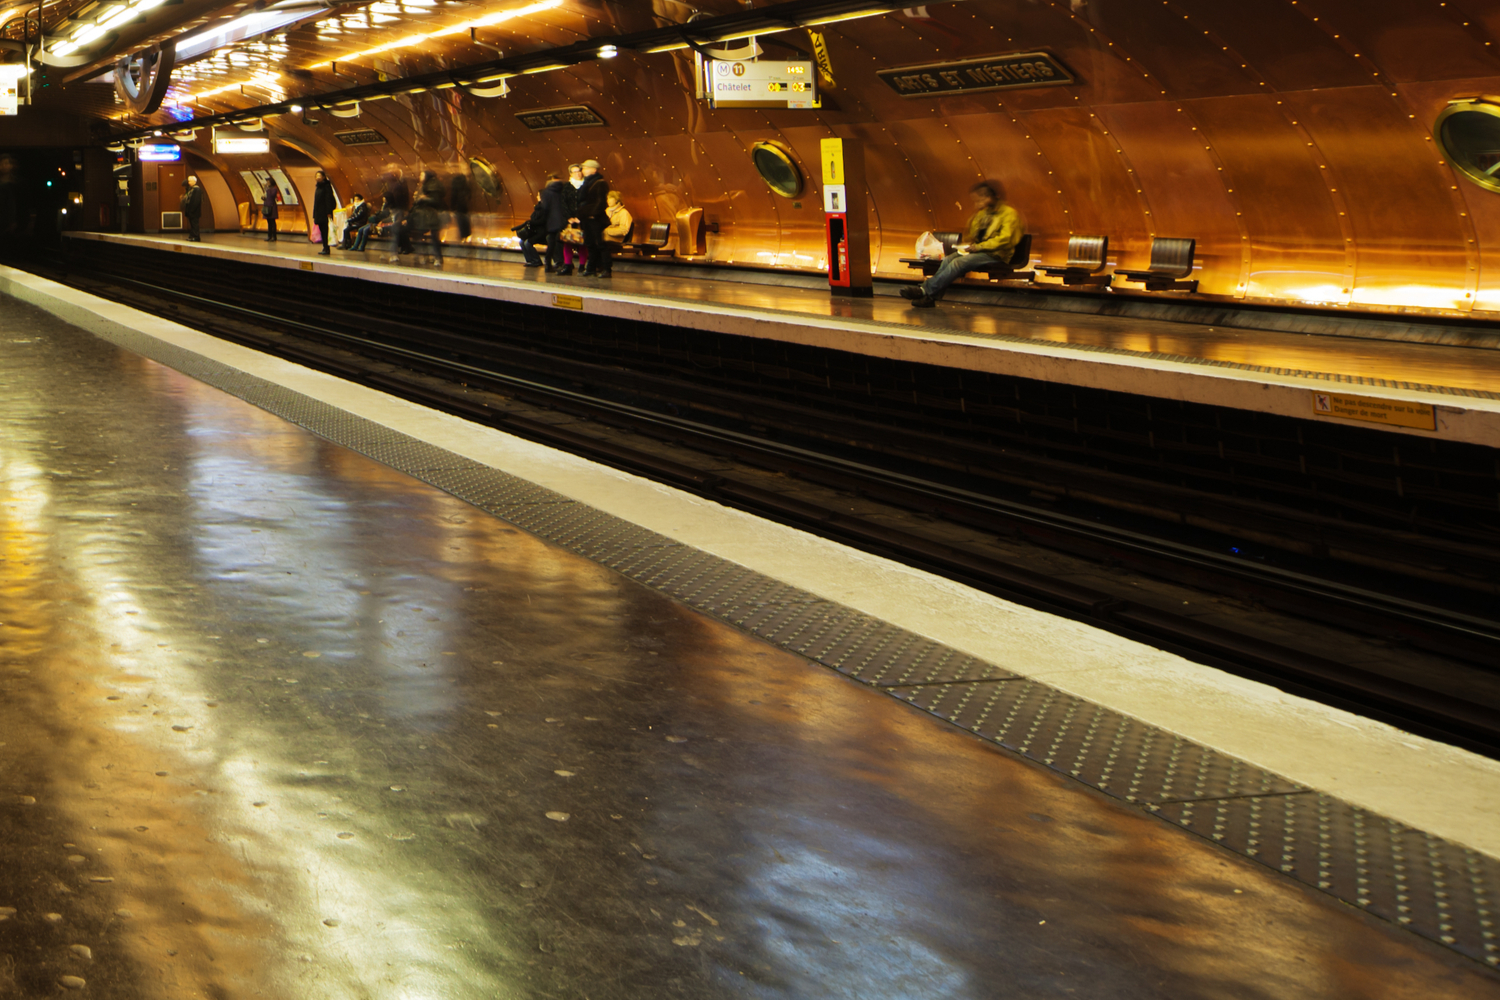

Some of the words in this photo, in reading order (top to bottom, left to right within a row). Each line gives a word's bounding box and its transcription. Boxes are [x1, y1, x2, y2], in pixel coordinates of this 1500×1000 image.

[734, 65, 743, 73] 11
[893, 73, 939, 92] ARTS
[939, 70, 965, 87] ET
[966, 61, 1054, 84] MÉTIERS
[717, 82, 751, 92] Châtelet
[1333, 396, 1343, 404] Ne
[1344, 398, 1356, 407] pas
[1358, 399, 1392, 411] descendre
[1394, 405, 1405, 413] sur
[1406, 405, 1414, 413] la
[1416, 407, 1431, 416] voie
[1333, 406, 1359, 417] Danger
[1360, 408, 1369, 416] de
[1370, 411, 1387, 419] mort
